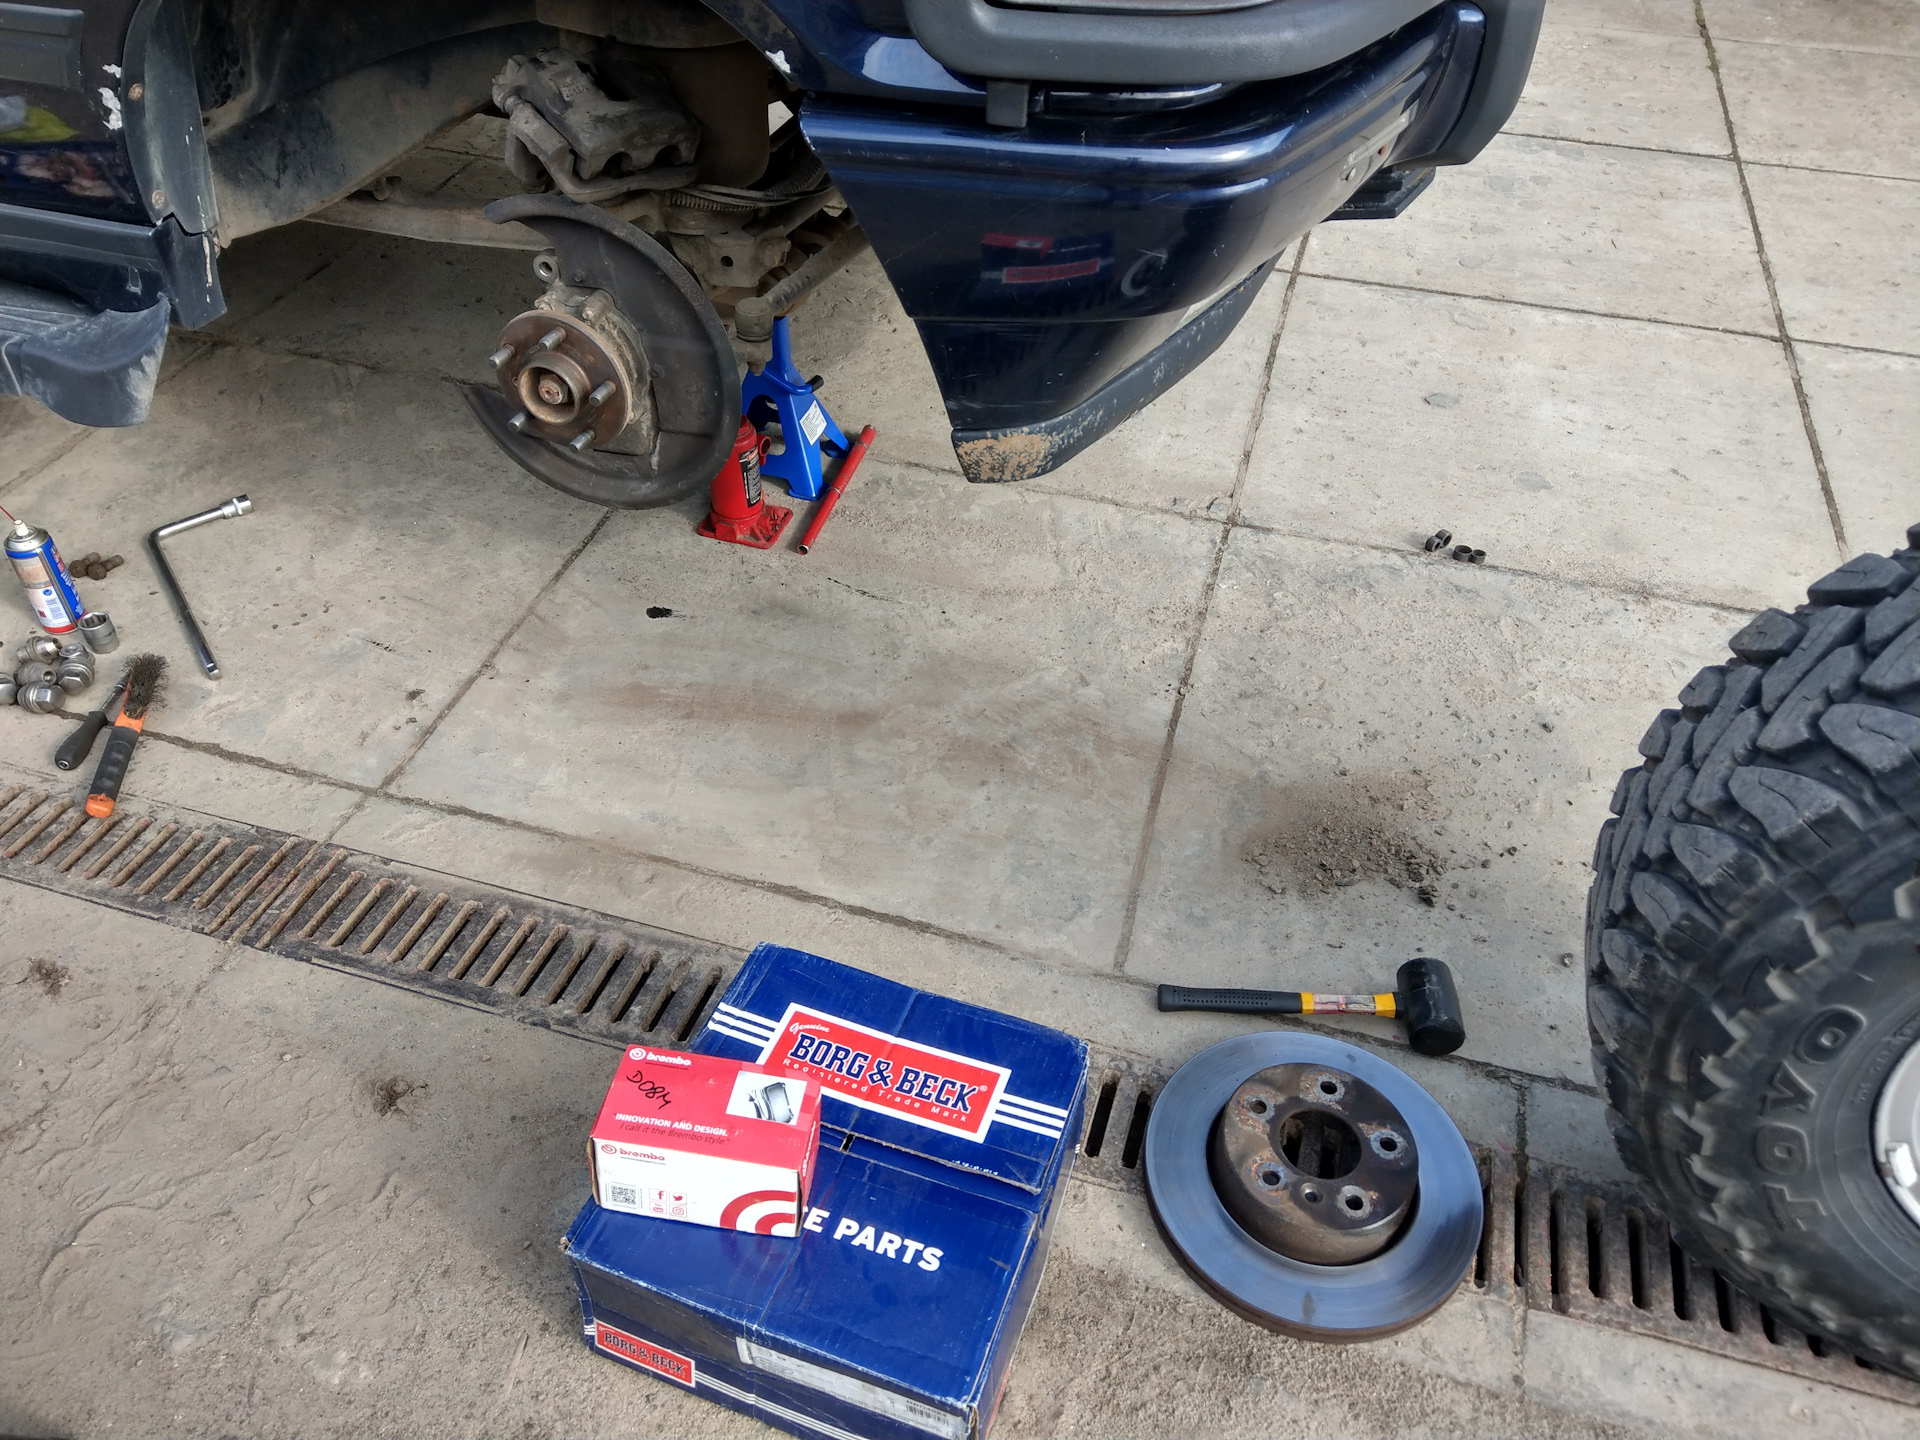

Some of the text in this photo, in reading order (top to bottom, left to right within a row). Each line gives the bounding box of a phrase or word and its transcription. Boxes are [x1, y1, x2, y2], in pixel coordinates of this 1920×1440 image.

[789, 1022, 830, 1035] Genuine
[646, 1051, 692, 1066] brembo
[787, 1032, 872, 1080] BORG
[866, 1057, 893, 1089] &
[878, 1090, 921, 1108] Trade
[930, 1106, 967, 1122] Mark
[625, 1124, 641, 1133] call
[642, 1126, 649, 1134] it
[651, 1127, 666, 1137] the
[667, 1129, 703, 1142] Brembo
[672, 1120, 692, 1131] AND
[693, 1125, 728, 1137] DESIGN.
[619, 1148, 666, 1161] brembo
[833, 1217, 945, 1272] PARTS
[604, 1331, 637, 1354] BORG
[638, 1346, 649, 1359] &
[651, 1352, 686, 1375] BECK
